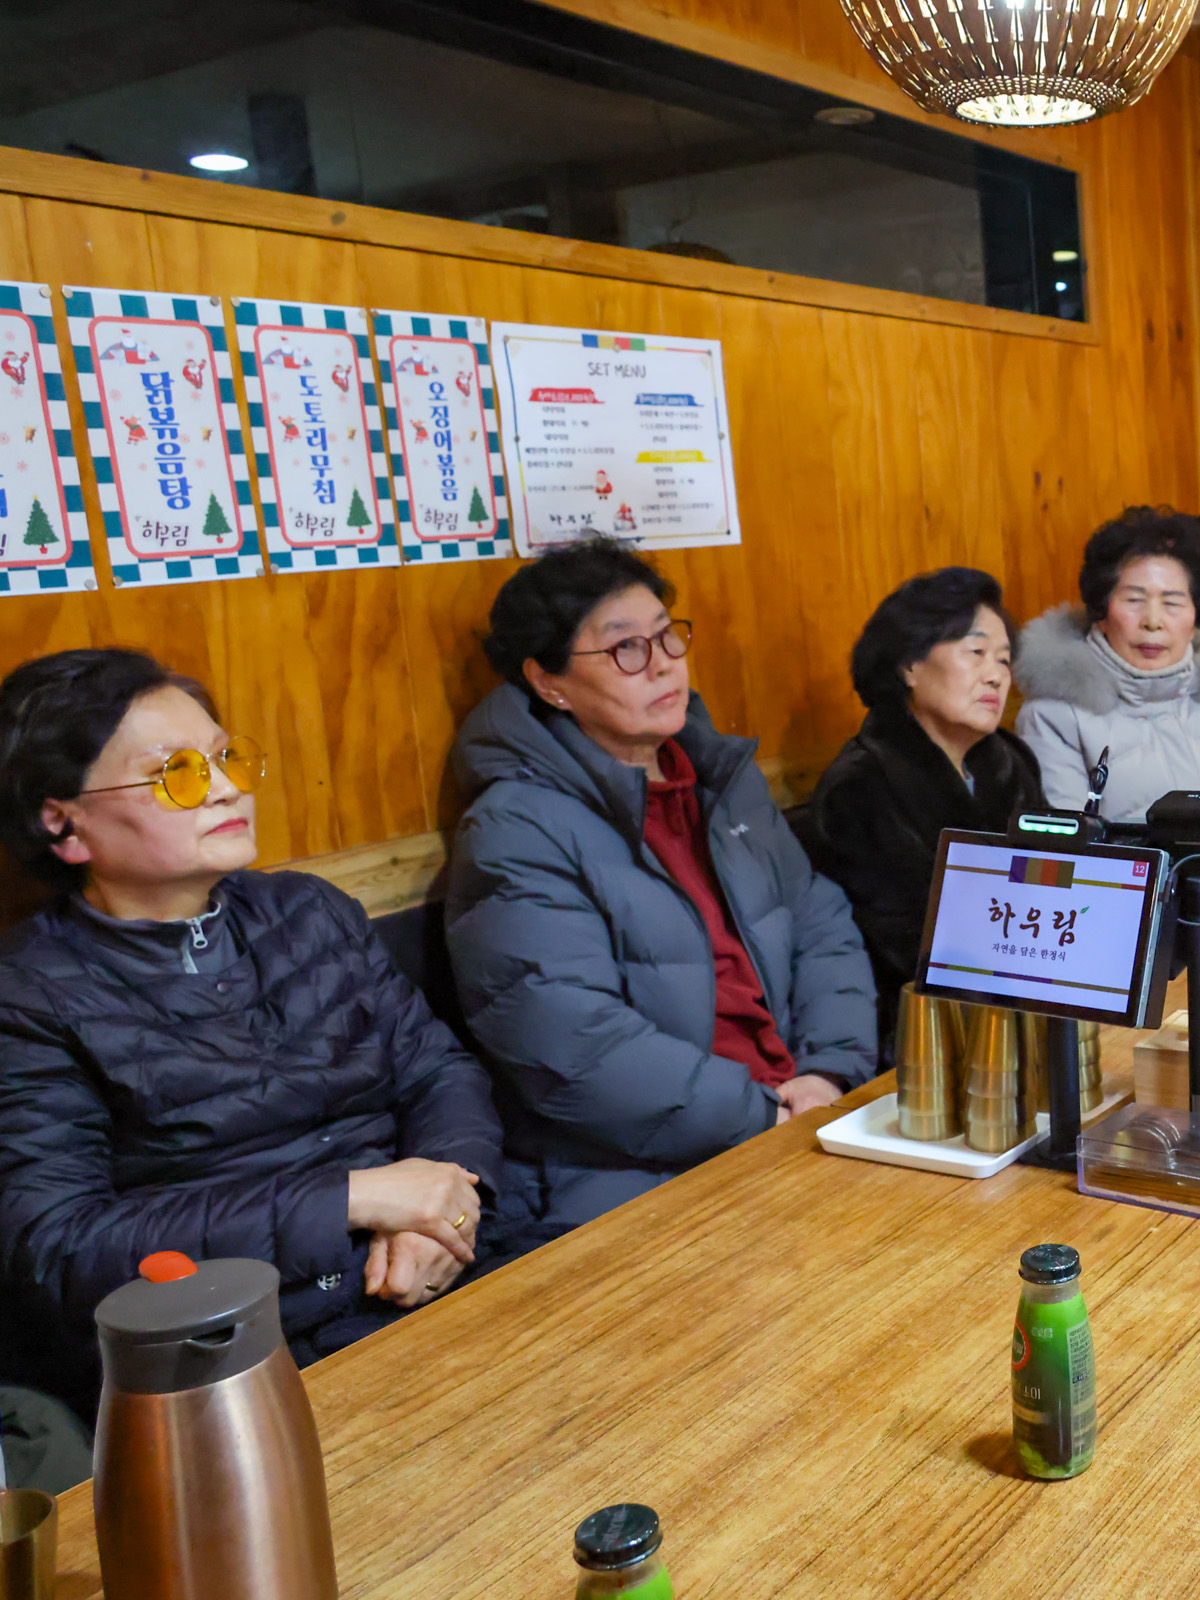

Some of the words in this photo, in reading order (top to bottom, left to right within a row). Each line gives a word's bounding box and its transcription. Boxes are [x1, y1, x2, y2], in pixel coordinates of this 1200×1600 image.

[588, 362, 609, 376] SET
[614, 364, 647, 379] MENU
[140, 371, 192, 510] 닭볶음탕
[299, 375, 336, 505] 도토리무침
[428, 381, 459, 502] 오징어볶음
[295, 512, 335, 537] 하우림
[424, 508, 458, 531] 하우림
[142, 520, 189, 547] 하우림
[1135, 865, 1145, 874] 12
[988, 897, 1077, 947] 하우림
[992, 943, 1017, 956] 자연을
[1020, 946, 1037, 958] 담은
[1041, 949, 1066, 962] 한정식
